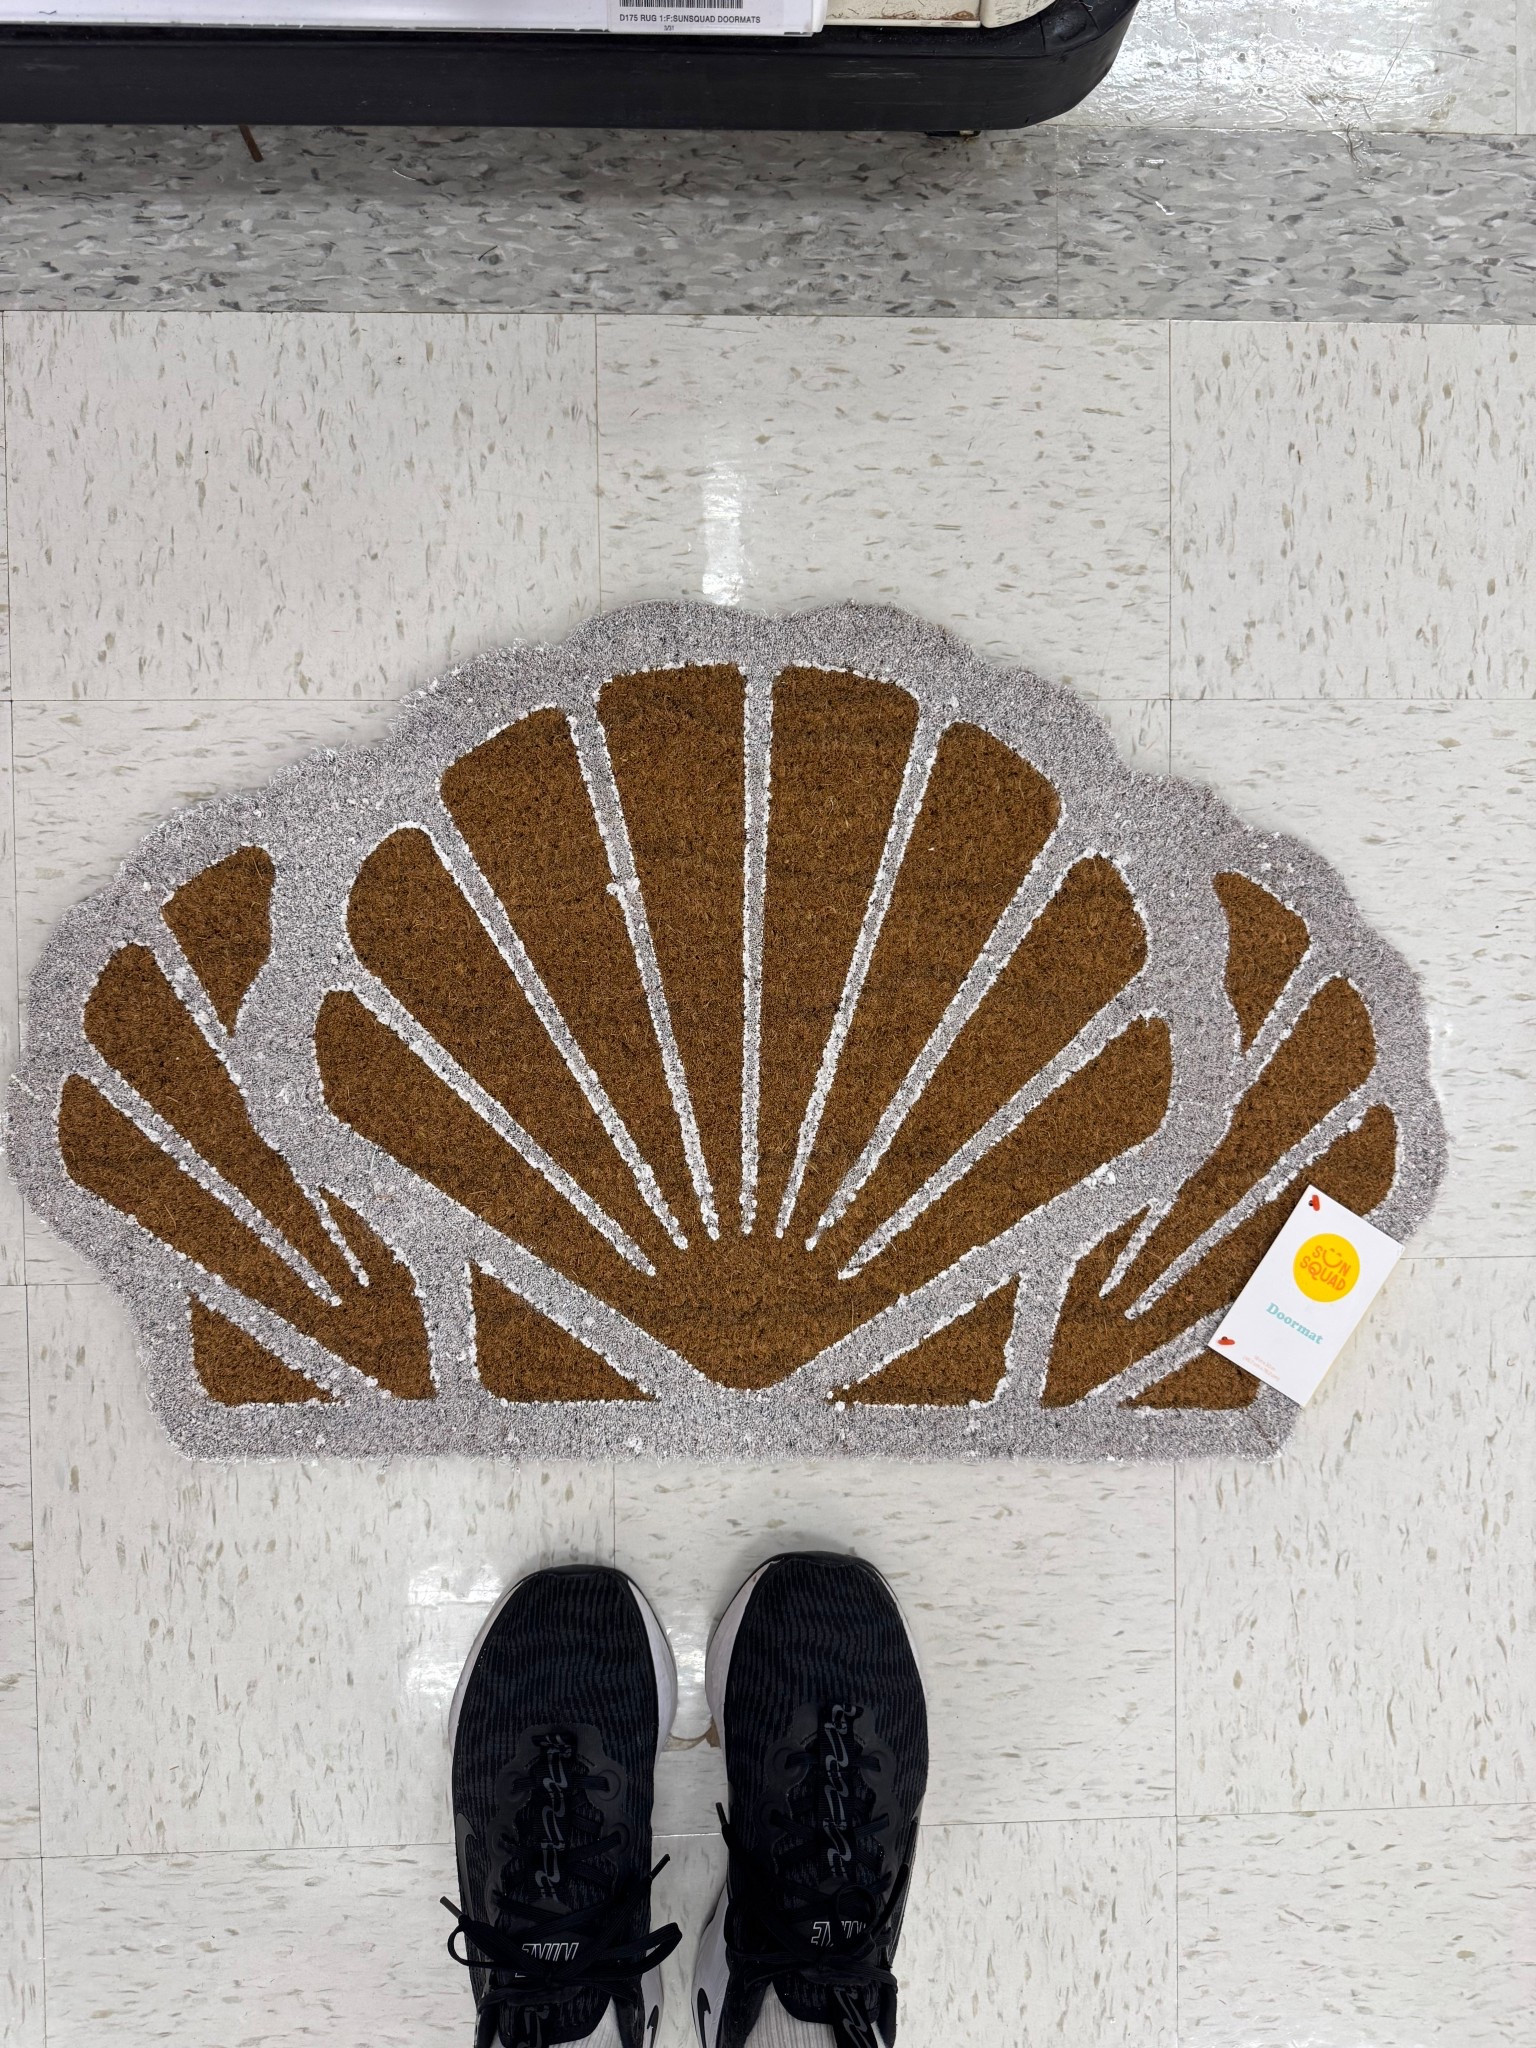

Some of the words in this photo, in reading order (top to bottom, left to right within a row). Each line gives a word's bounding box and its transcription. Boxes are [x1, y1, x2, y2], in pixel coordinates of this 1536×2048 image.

[619, 14, 639, 22] D175
[640, 14, 657, 22] RUG
[659, 14, 716, 23] 1:F:SUNSQUAD
[717, 15, 761, 24] DOORMATS
[1299, 1255, 1346, 1292] SQUAD
[1312, 1245, 1352, 1277] SUN
[1265, 1302, 1325, 1345] Doormat
